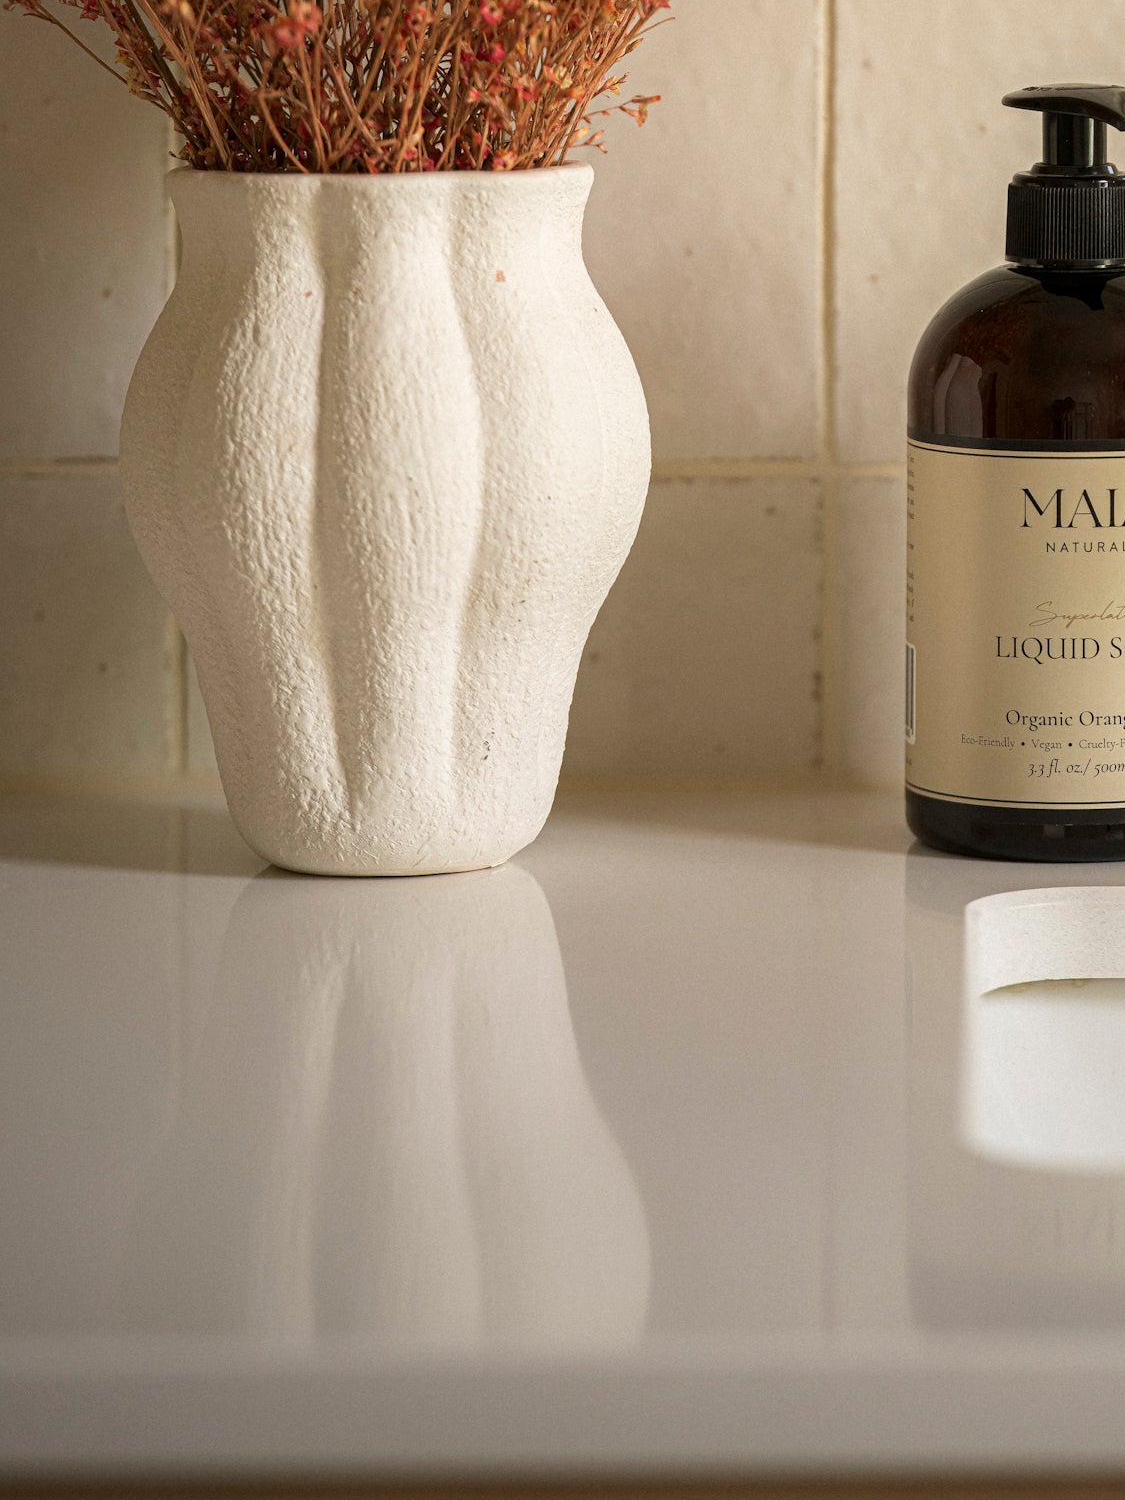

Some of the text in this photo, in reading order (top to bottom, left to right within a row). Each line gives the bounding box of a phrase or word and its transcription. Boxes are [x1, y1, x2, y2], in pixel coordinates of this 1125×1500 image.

[995, 636, 1100, 665] LIQUID
[1005, 709, 1073, 731] Organic
[960, 733, 1015, 750] Eco-Friendly
[1031, 739, 1062, 752] Vegan
[1027, 762, 1045, 777] 3.3
[1046, 757, 1062, 778] fl.
